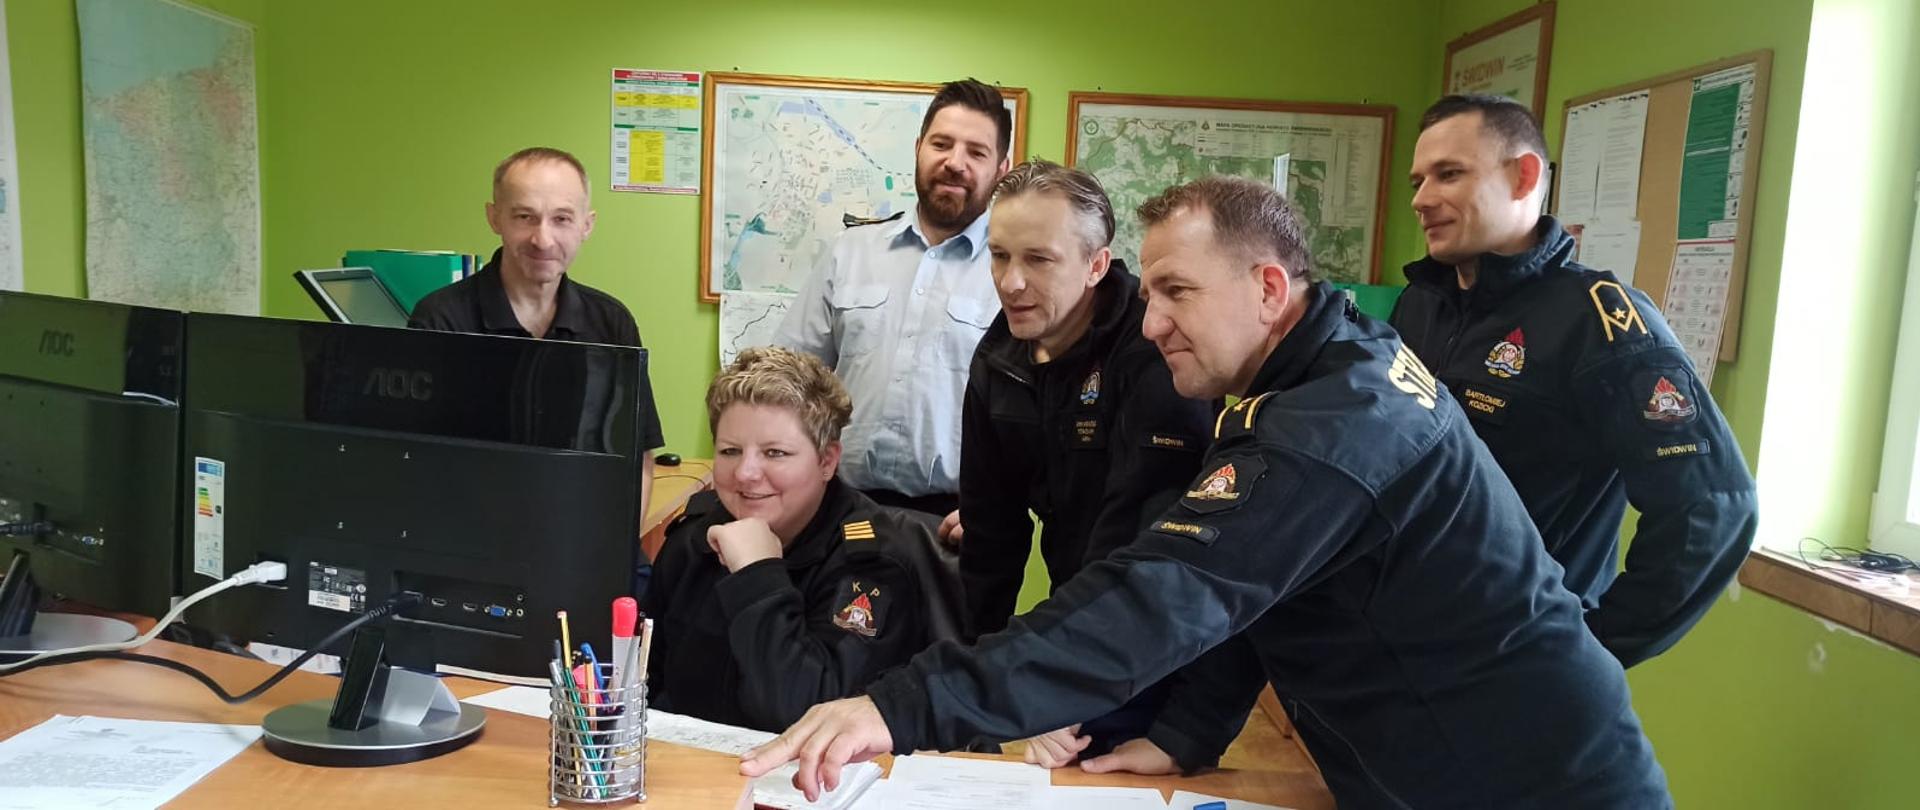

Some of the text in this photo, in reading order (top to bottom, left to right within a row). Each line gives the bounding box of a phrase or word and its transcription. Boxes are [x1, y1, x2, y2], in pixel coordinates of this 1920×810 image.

[362, 367, 433, 400] AOC
[852, 582, 880, 597] K P
